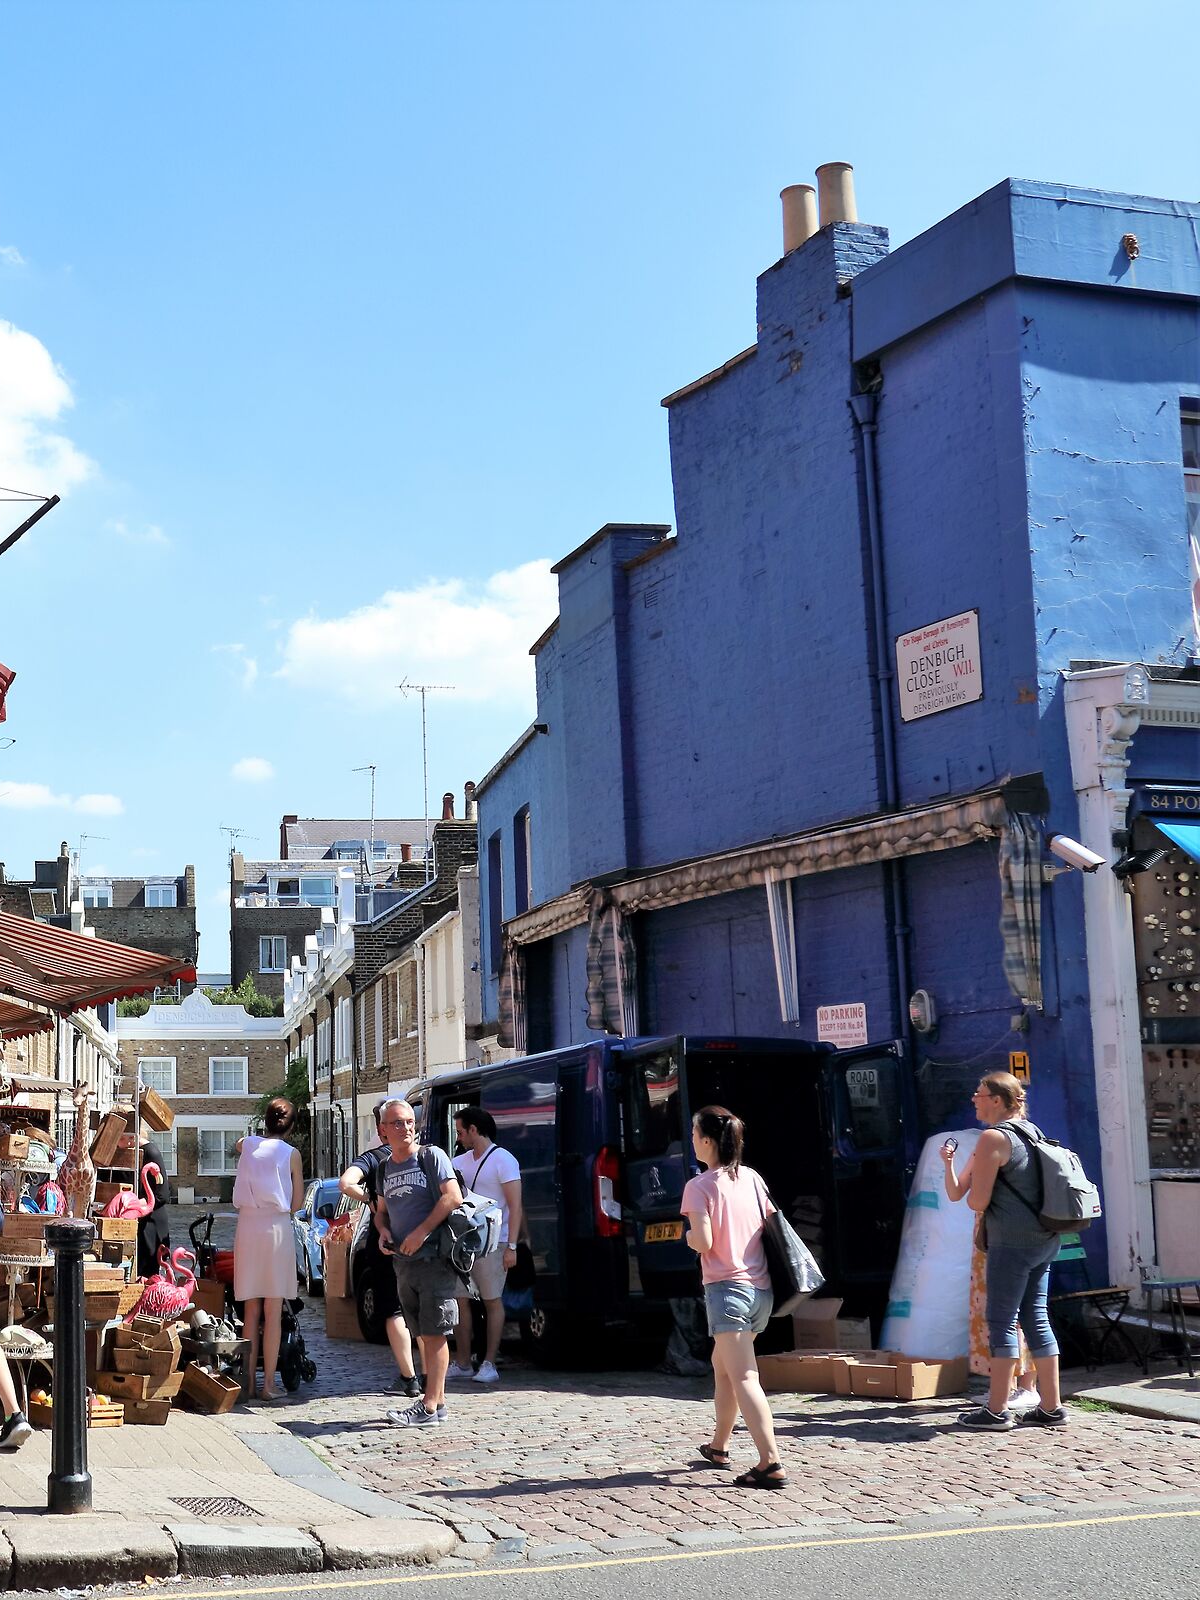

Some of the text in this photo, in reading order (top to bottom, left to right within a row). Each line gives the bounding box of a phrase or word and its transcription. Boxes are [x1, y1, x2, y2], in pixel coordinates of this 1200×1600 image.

[910, 643, 965, 675] DENBIGH
[919, 681, 959, 702] PREVIOUSLY
[913, 690, 967, 715] DENBIGH MEWS
[1151, 794, 1200, 810] 84 PO
[819, 1006, 864, 1022] NO PARKING
[820, 1023, 836, 1032] EXCEPT
[837, 1022, 847, 1031] FOR
[850, 1070, 875, 1083] ROAD
[0, 1108, 44, 1120] DOCTOR
